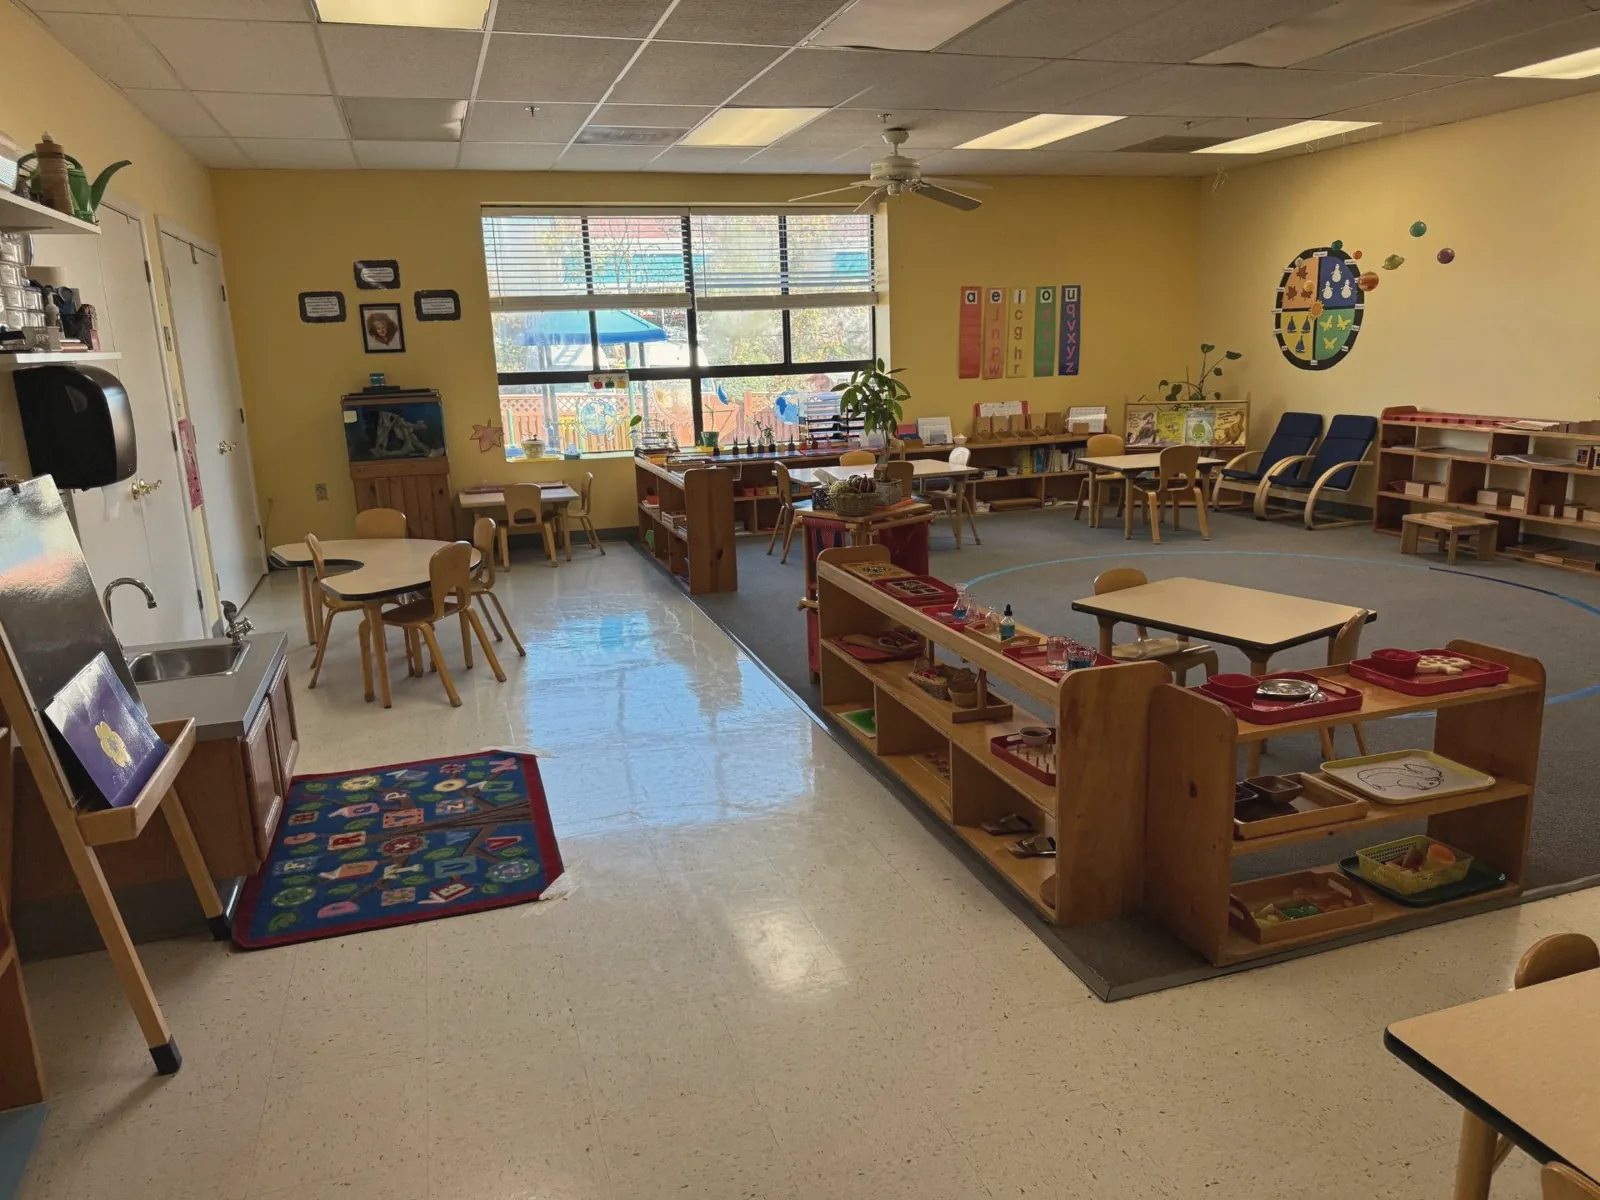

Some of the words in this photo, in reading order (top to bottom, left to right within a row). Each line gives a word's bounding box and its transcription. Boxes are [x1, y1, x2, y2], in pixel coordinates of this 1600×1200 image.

[967, 292, 976, 303] a
[992, 291, 1000, 302] e
[1042, 290, 1051, 301] o
[1068, 289, 1076, 300] u
[1014, 309, 1023, 320] c
[1066, 304, 1075, 318] q
[1066, 320, 1076, 332] v
[992, 329, 1000, 340] n
[1014, 326, 1022, 340] g
[1066, 332, 1076, 344] x
[992, 347, 1000, 360] p
[1014, 346, 1022, 360] h
[1066, 346, 1075, 360] y
[989, 364, 1000, 375] w
[1014, 364, 1020, 374] r
[1065, 362, 1074, 373] z
[385, 790, 406, 800] P
[332, 833, 362, 846] R
[394, 842, 410, 850] X
